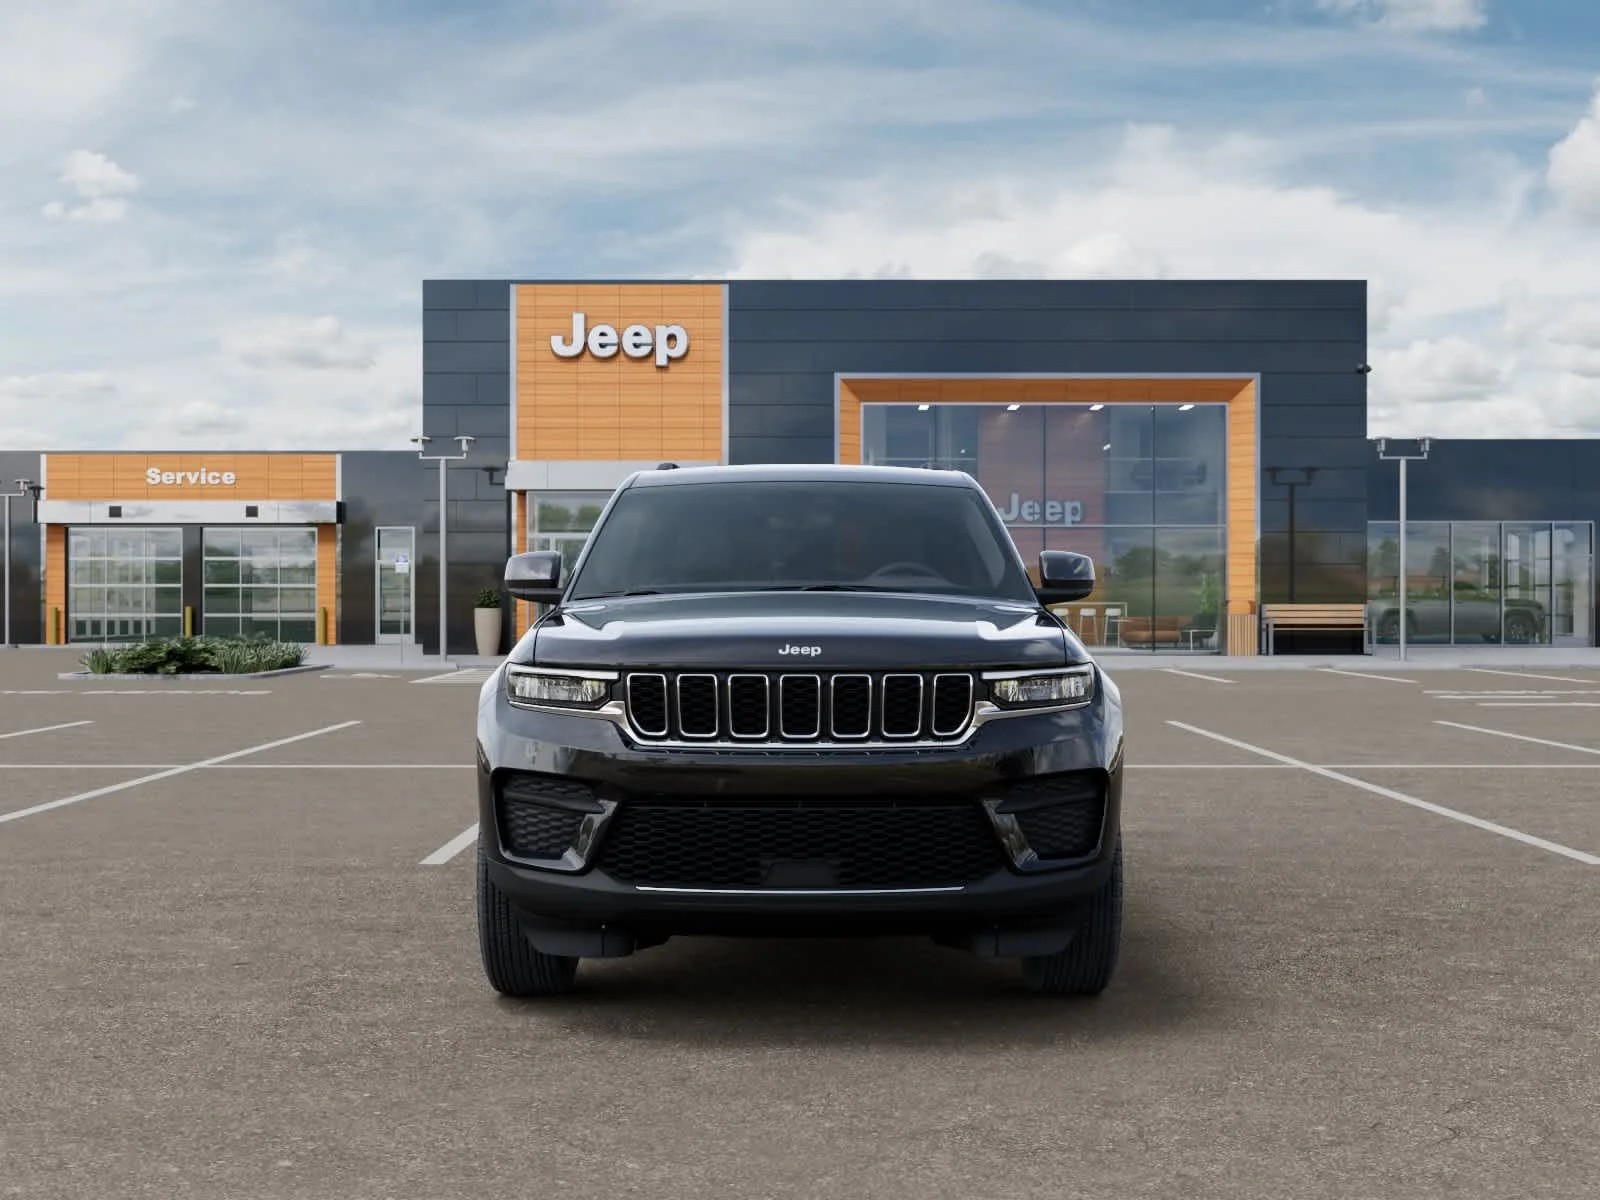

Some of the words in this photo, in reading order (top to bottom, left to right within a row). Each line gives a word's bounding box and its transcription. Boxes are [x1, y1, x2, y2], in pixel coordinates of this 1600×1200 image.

[550, 312, 689, 367] Jeep
[146, 467, 236, 485] Service
[998, 493, 1082, 526] Jeep
[778, 644, 822, 656] Jeep
